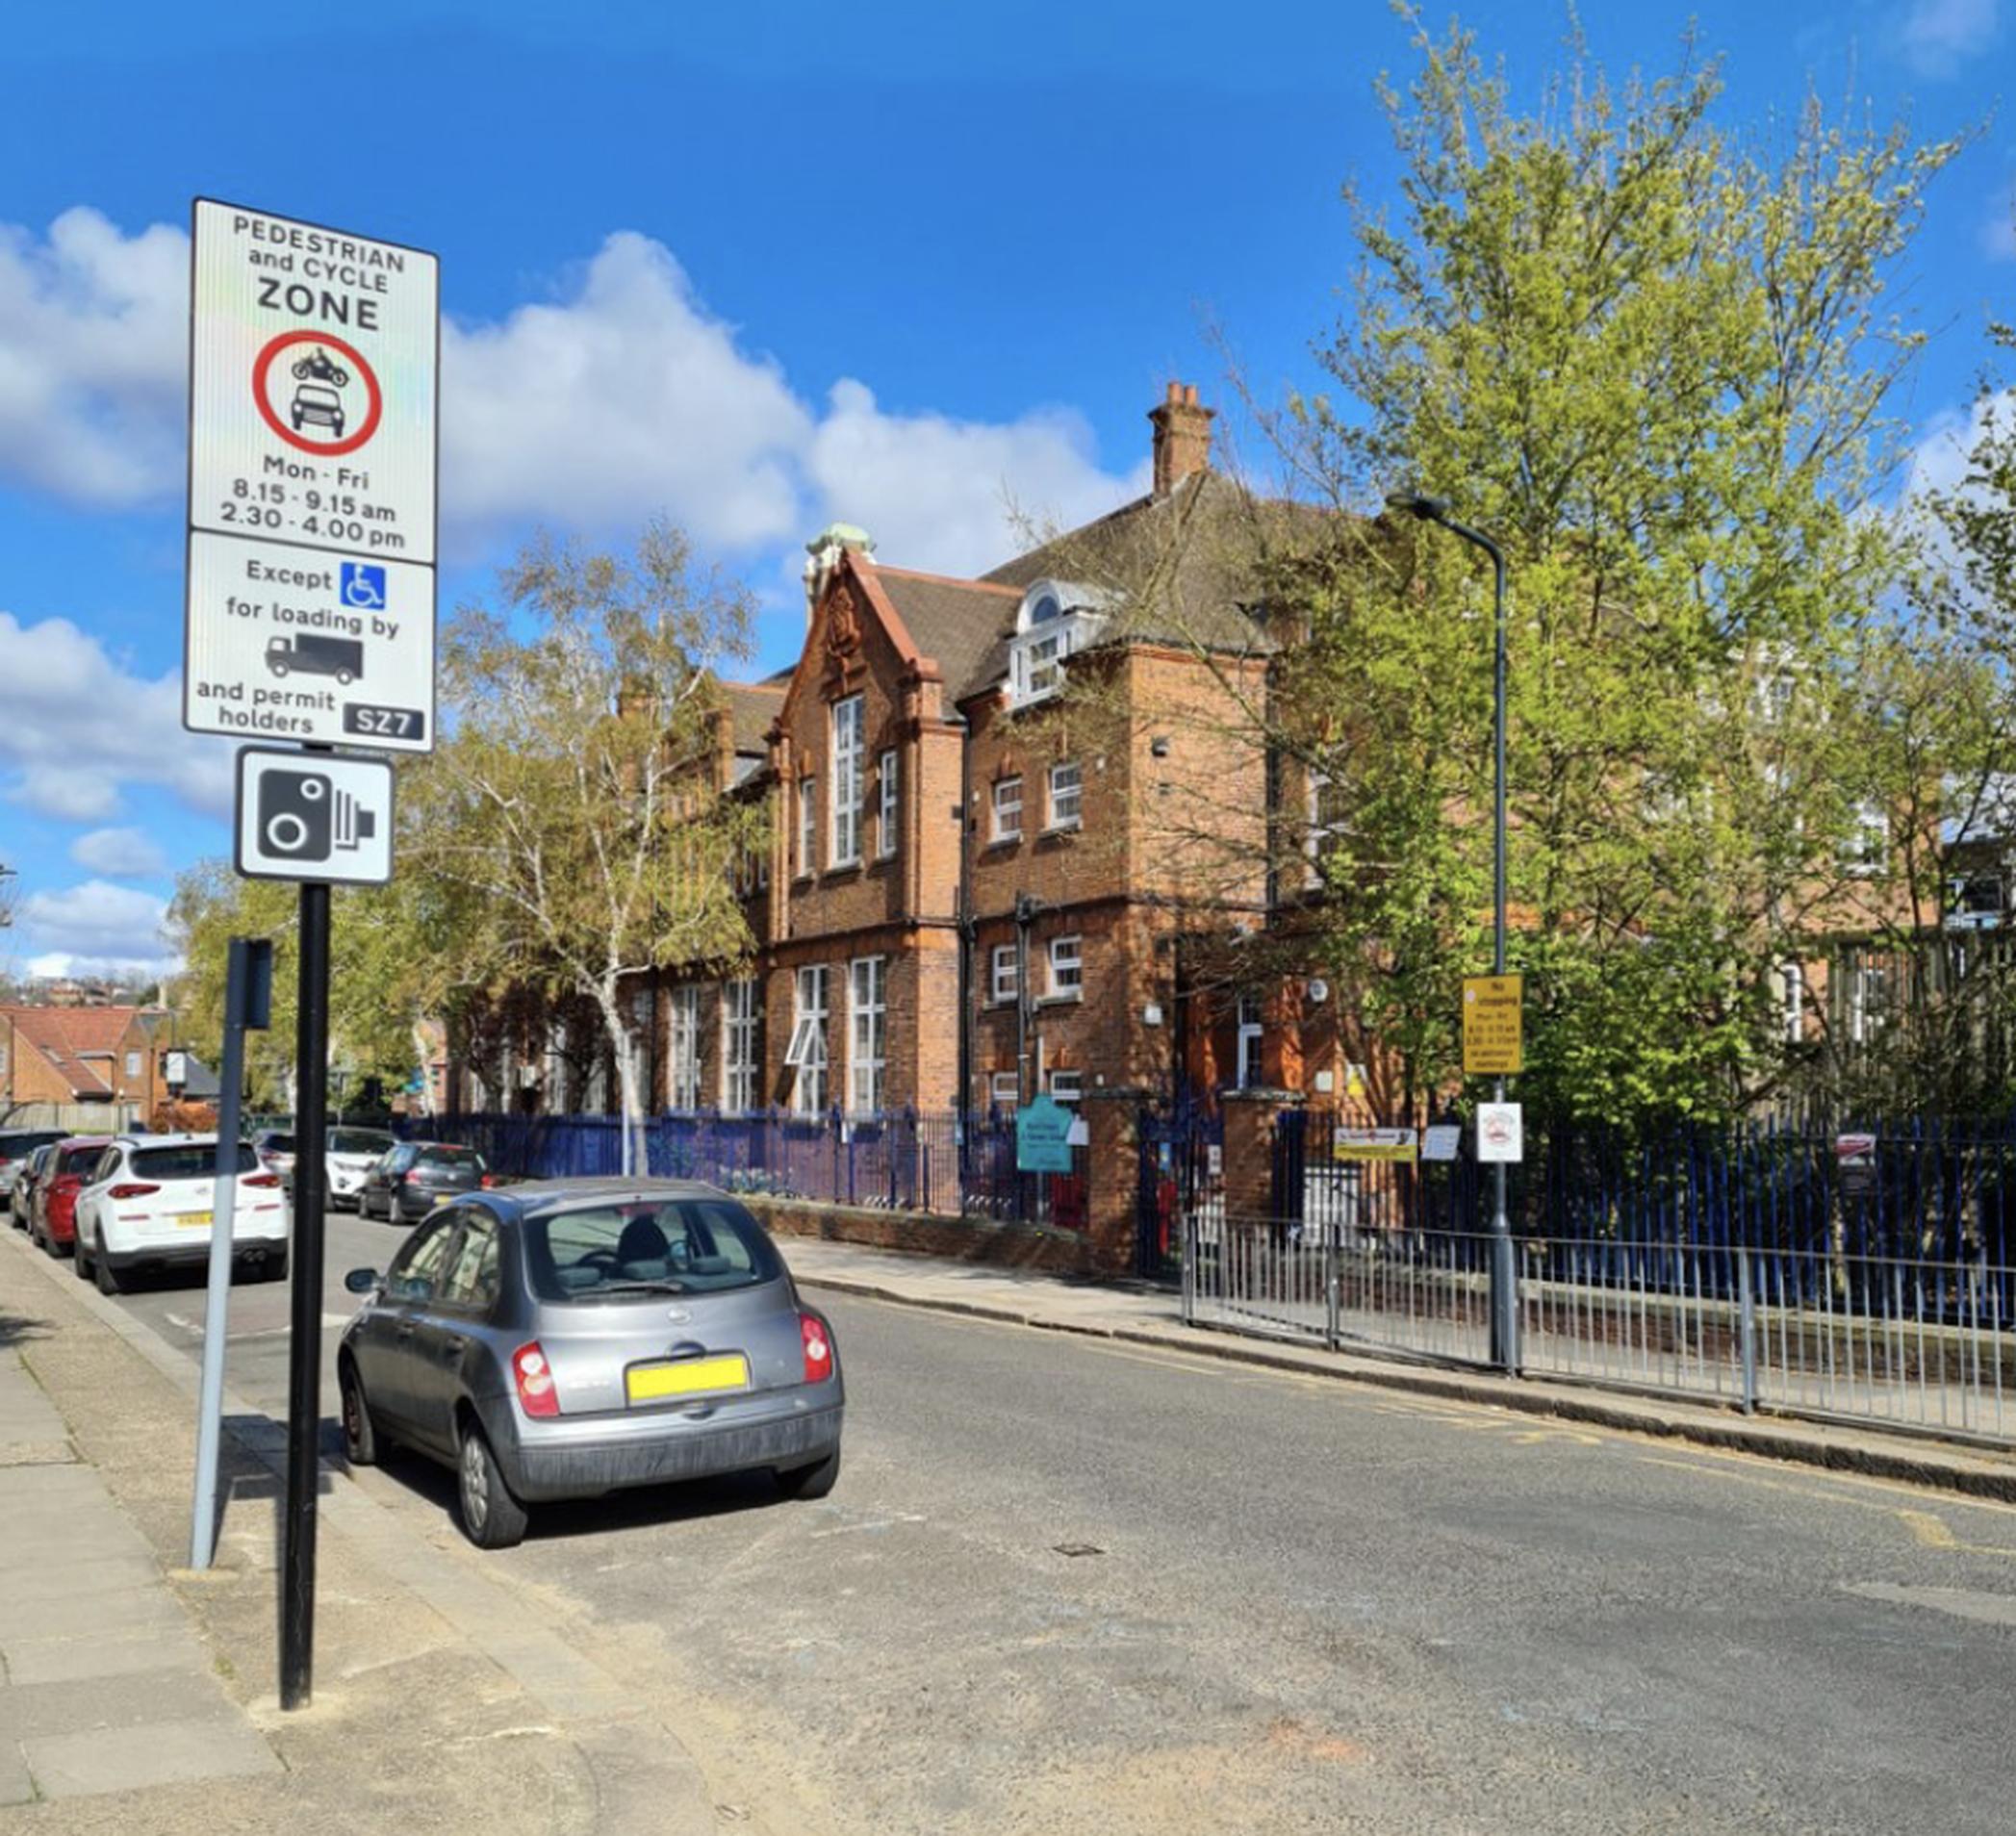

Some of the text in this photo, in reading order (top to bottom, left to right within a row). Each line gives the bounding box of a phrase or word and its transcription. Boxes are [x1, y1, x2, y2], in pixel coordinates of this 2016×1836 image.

[234, 215, 404, 272] PEDESTRIAN
[248, 248, 388, 293] and CYCLE
[257, 276, 378, 331] ZONE
[263, 454, 316, 480] Mon
[338, 468, 369, 490] Fri
[233, 478, 285, 504] 8.15
[305, 491, 355, 516] 9.15
[362, 504, 396, 522] am
[220, 501, 282, 528] 2.30
[301, 516, 363, 541] 4.00
[370, 530, 404, 548] pm
[246, 560, 332, 590] Except
[226, 597, 399, 639] for loading by
[196, 681, 336, 711] and permit
[218, 706, 314, 733] holders
[356, 709, 411, 734] SZ7
